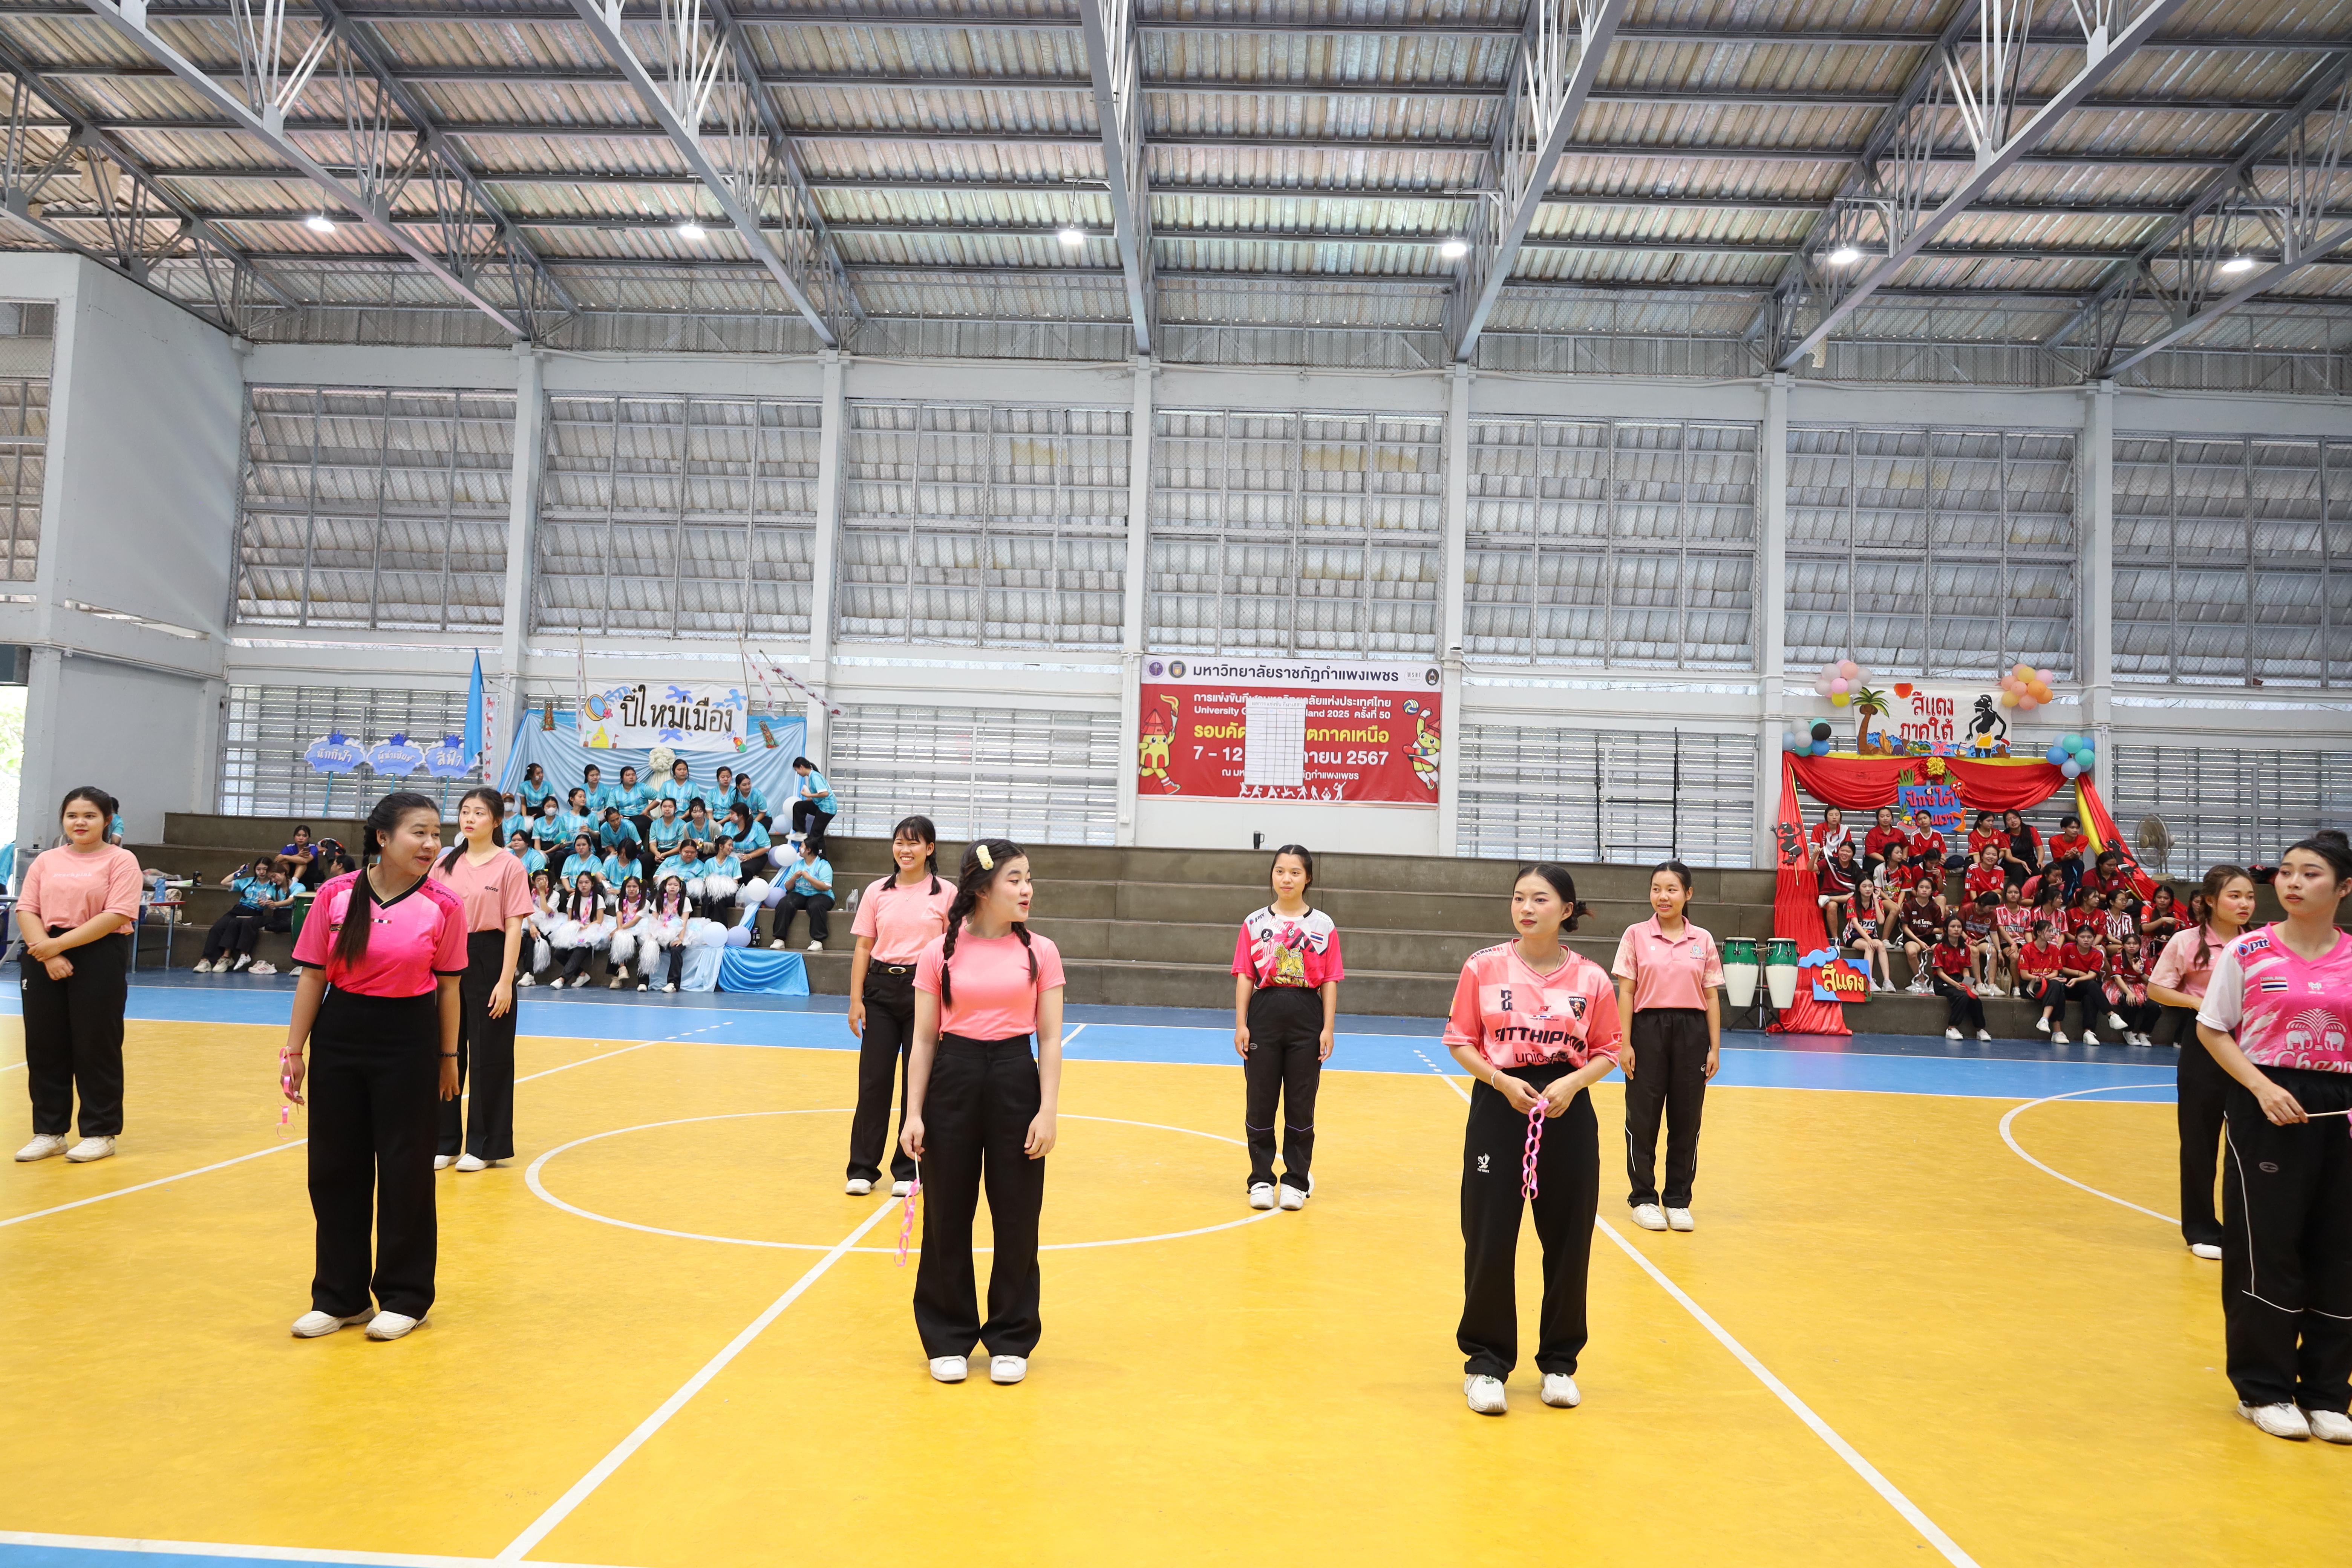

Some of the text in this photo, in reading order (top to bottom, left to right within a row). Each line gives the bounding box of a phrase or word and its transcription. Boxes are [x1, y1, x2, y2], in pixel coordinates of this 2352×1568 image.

[1193, 664, 1399, 682] มหาวิทยาลัยราชภัฏกำแพงเพชร
[1194, 706, 1239, 717] University
[1354, 707, 1377, 719] ครั้งที่
[1911, 691, 1953, 716] สีแดง
[1899, 717, 1953, 741] ภาคใต้
[1193, 746, 1204, 760] 7
[1222, 747, 1243, 761] 12
[1346, 750, 1389, 765] 2567
[2250, 939, 2269, 952] ptt
[1821, 963, 1864, 992] สีแดง
